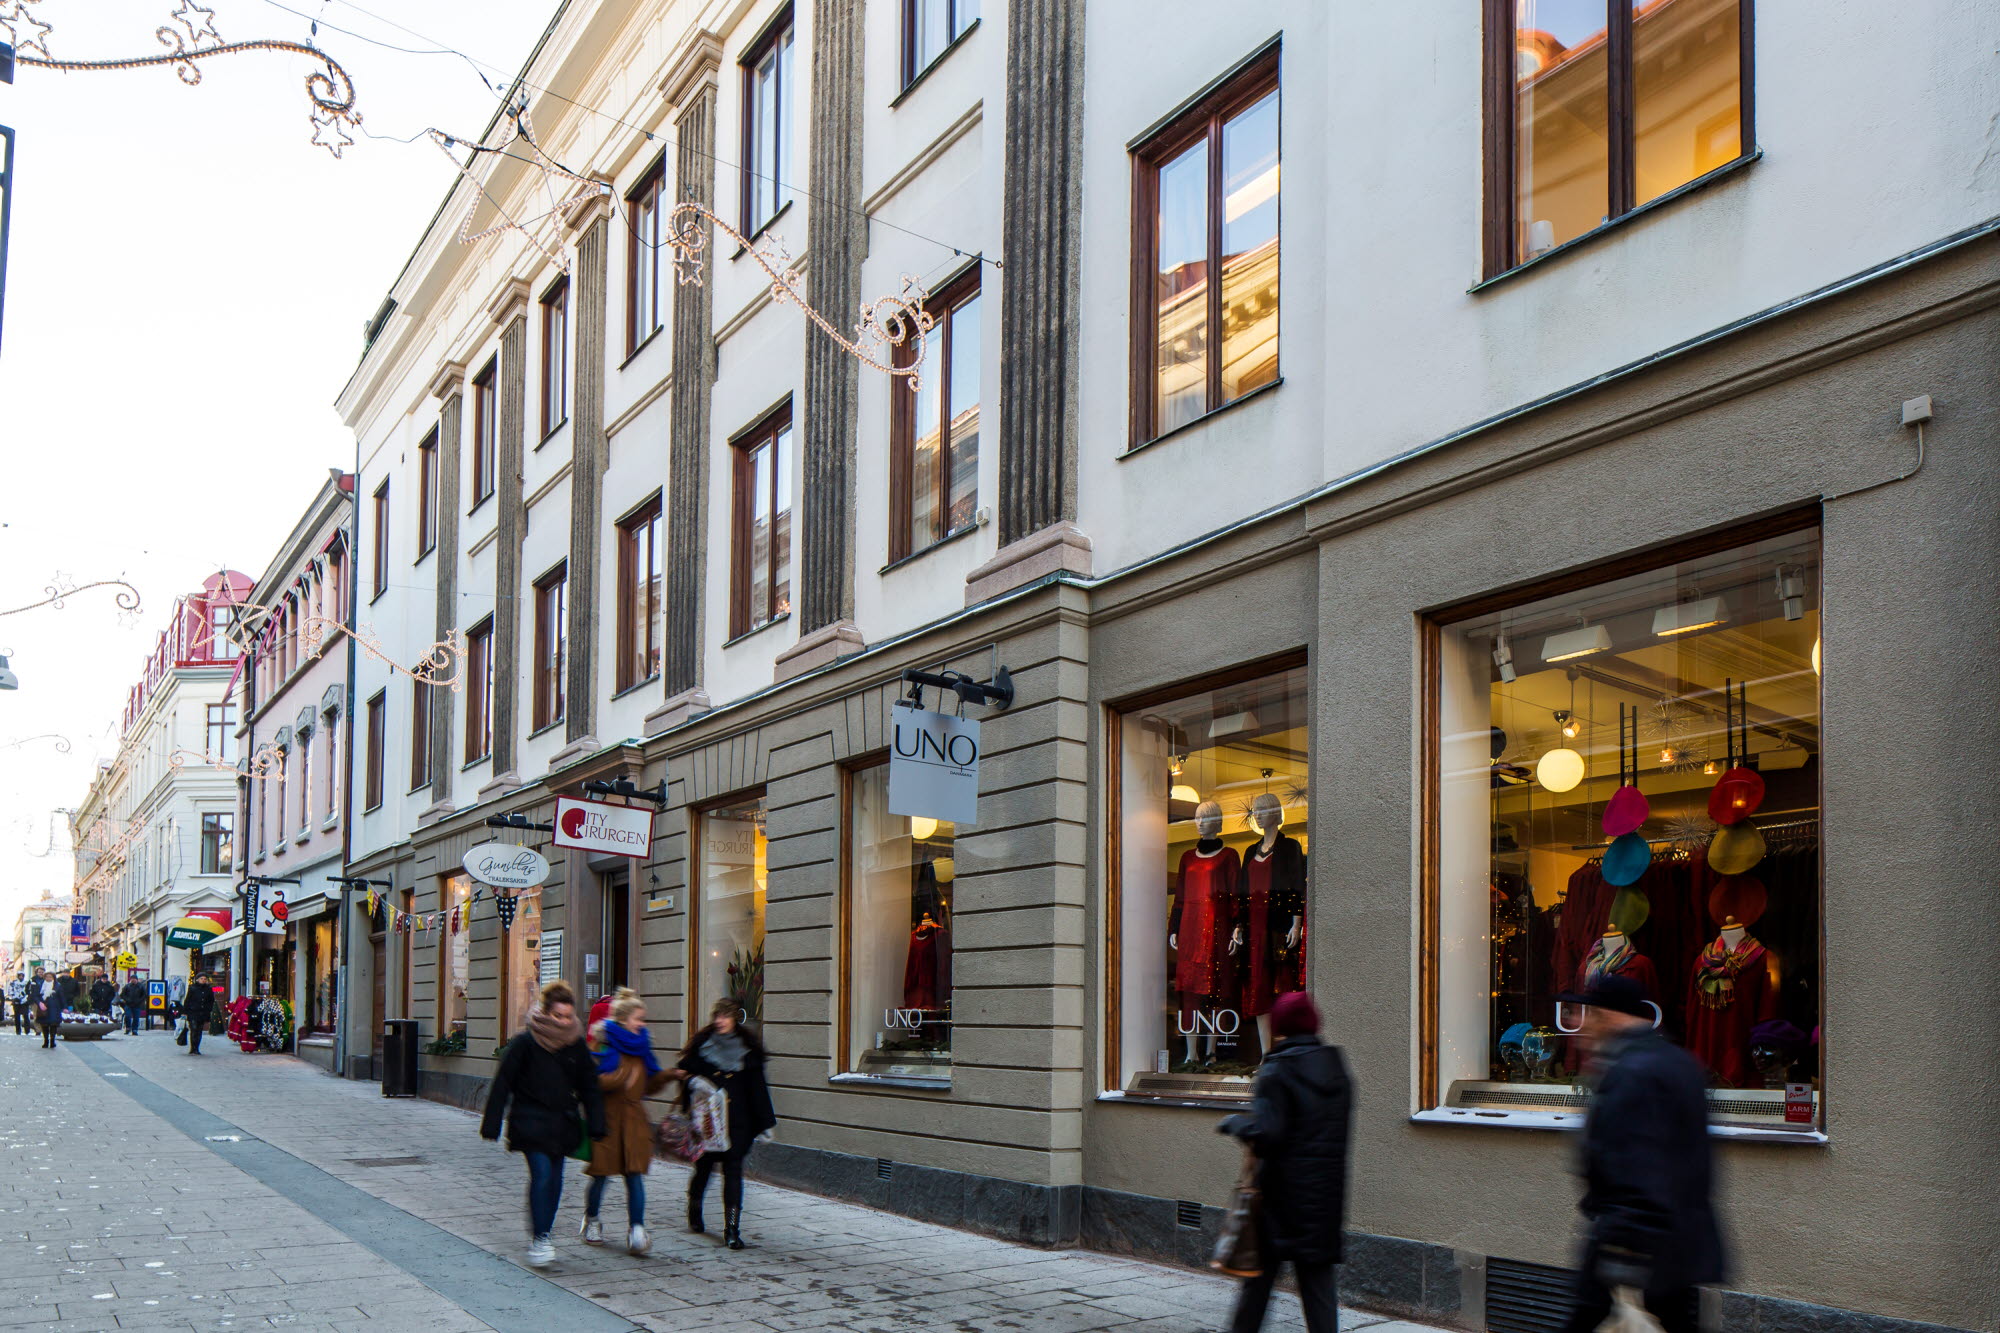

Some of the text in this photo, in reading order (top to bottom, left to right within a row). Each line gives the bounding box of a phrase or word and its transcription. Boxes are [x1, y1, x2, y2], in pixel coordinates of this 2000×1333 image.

[895, 724, 977, 766] UNO
[574, 823, 646, 845] KIRURGEN
[478, 851, 537, 876] Gunillas
[885, 1009, 922, 1028] UNO
[1178, 1009, 1240, 1034] UNO
